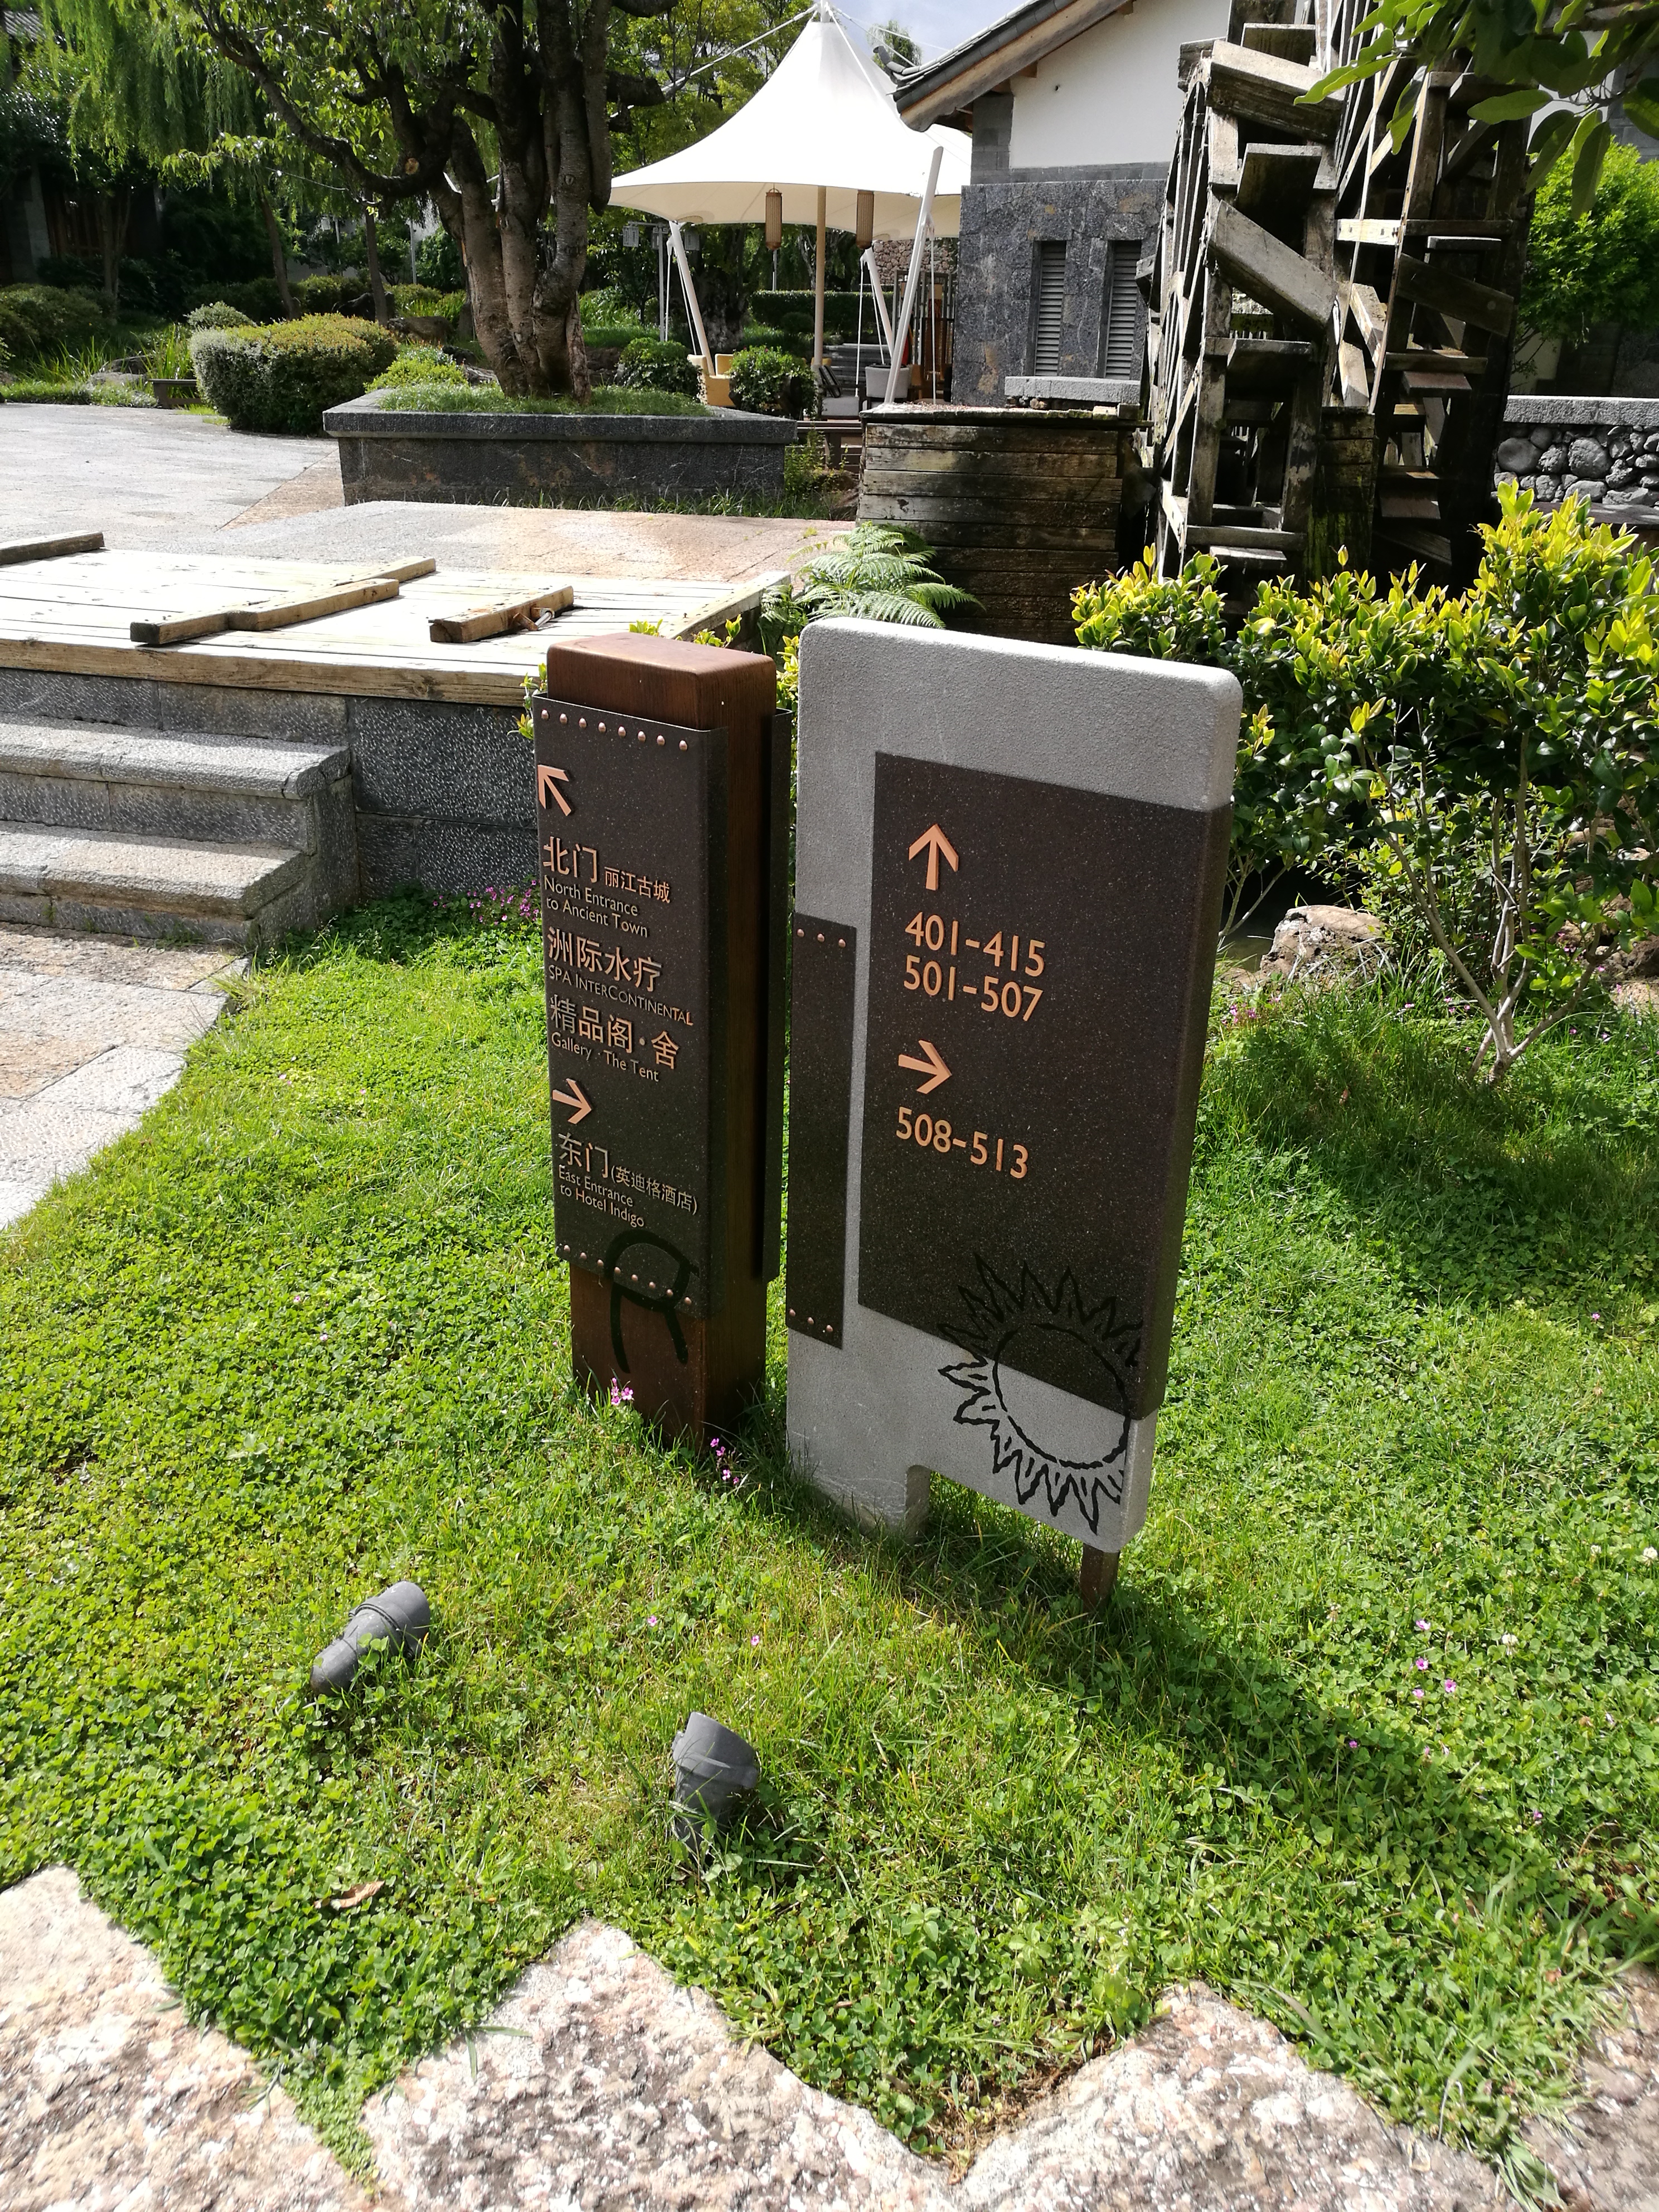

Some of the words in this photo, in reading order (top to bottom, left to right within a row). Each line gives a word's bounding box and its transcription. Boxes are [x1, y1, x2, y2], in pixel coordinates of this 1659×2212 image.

[543, 836, 598, 884] 北门
[604, 866, 671, 904] 丽江古城
[544, 875, 581, 900] North
[585, 887, 638, 916] Entrance
[546, 898, 559, 911] to
[562, 899, 609, 925] Ancient
[612, 913, 648, 938] Town
[547, 925, 663, 992] 洲际水疗
[905, 911, 1046, 977] 401-415
[549, 965, 572, 986] SPA
[904, 954, 1044, 1022] 501-507
[551, 1032, 592, 1061] Gallery
[603, 1050, 627, 1071] The
[630, 1058, 659, 1082] Tent
[896, 1107, 1029, 1179] 508-513
[559, 1164, 581, 1186] East
[585, 1176, 634, 1207] Entrance
[560, 1184, 573, 1197] to
[576, 1187, 607, 1212] Hotel
[610, 1201, 644, 1228] Indigo
